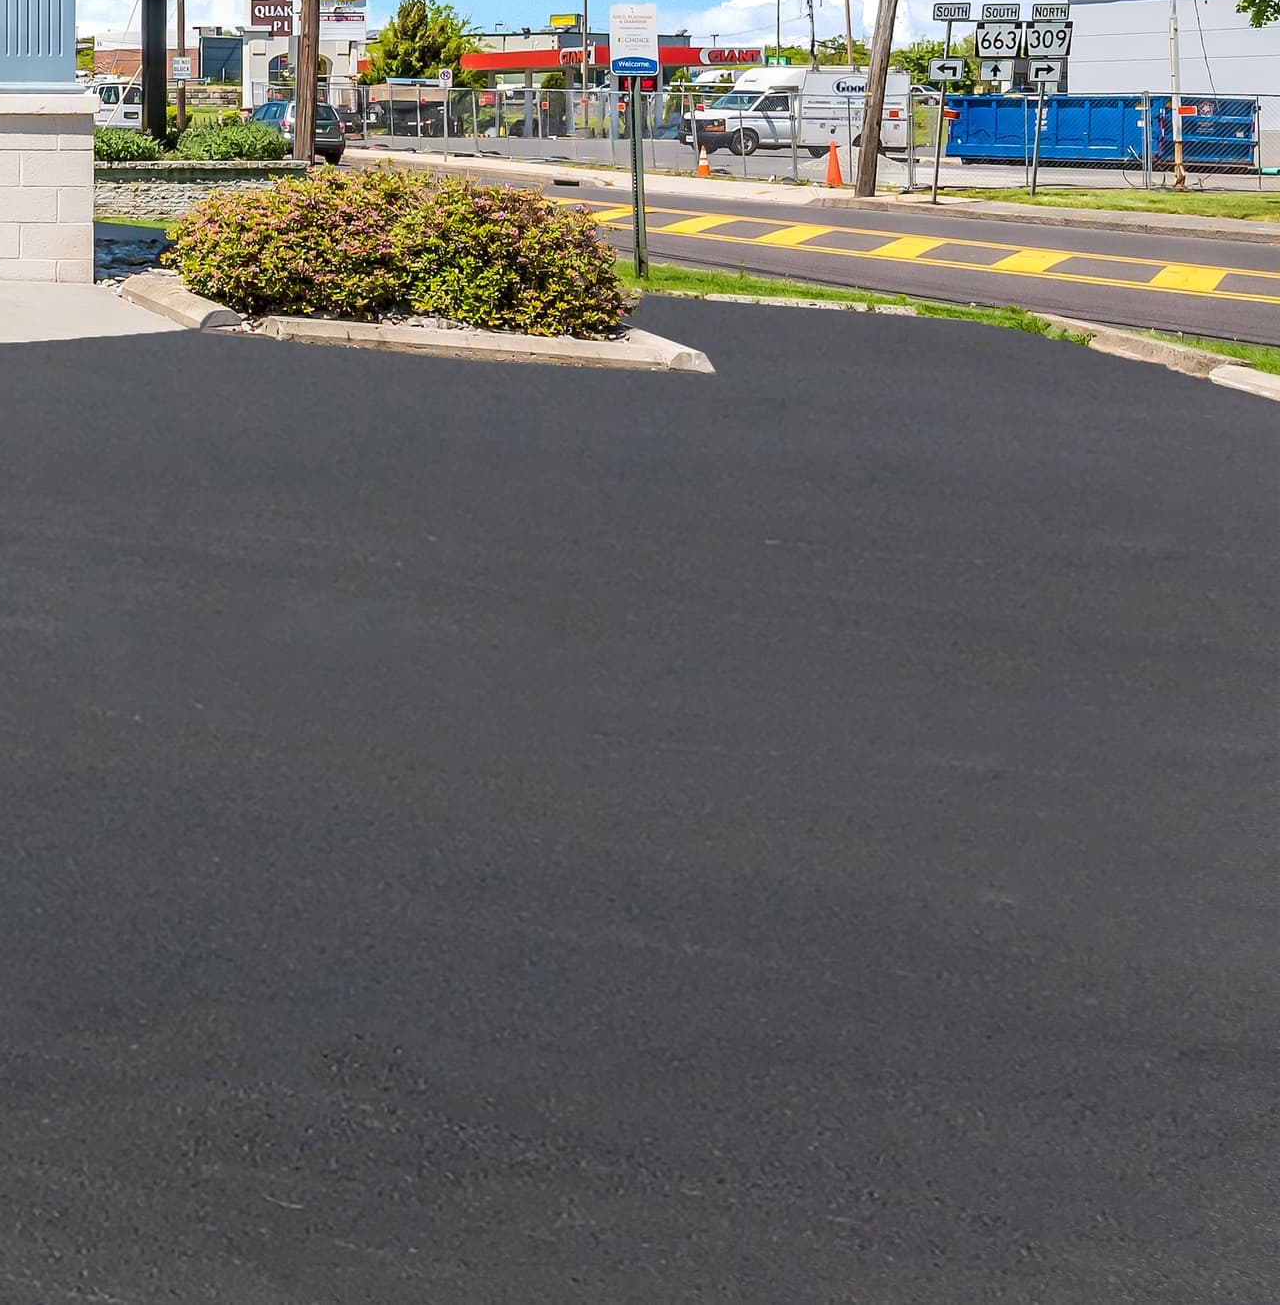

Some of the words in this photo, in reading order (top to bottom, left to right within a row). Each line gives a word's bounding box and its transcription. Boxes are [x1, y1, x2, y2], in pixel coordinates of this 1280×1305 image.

[935, 6, 968, 18] SOUTH
[985, 6, 1018, 19] SOUTH
[1034, 6, 1067, 18] NORTH
[980, 30, 1017, 50] 663
[1029, 29, 1067, 49] 309
[708, 49, 761, 63] GIANT
